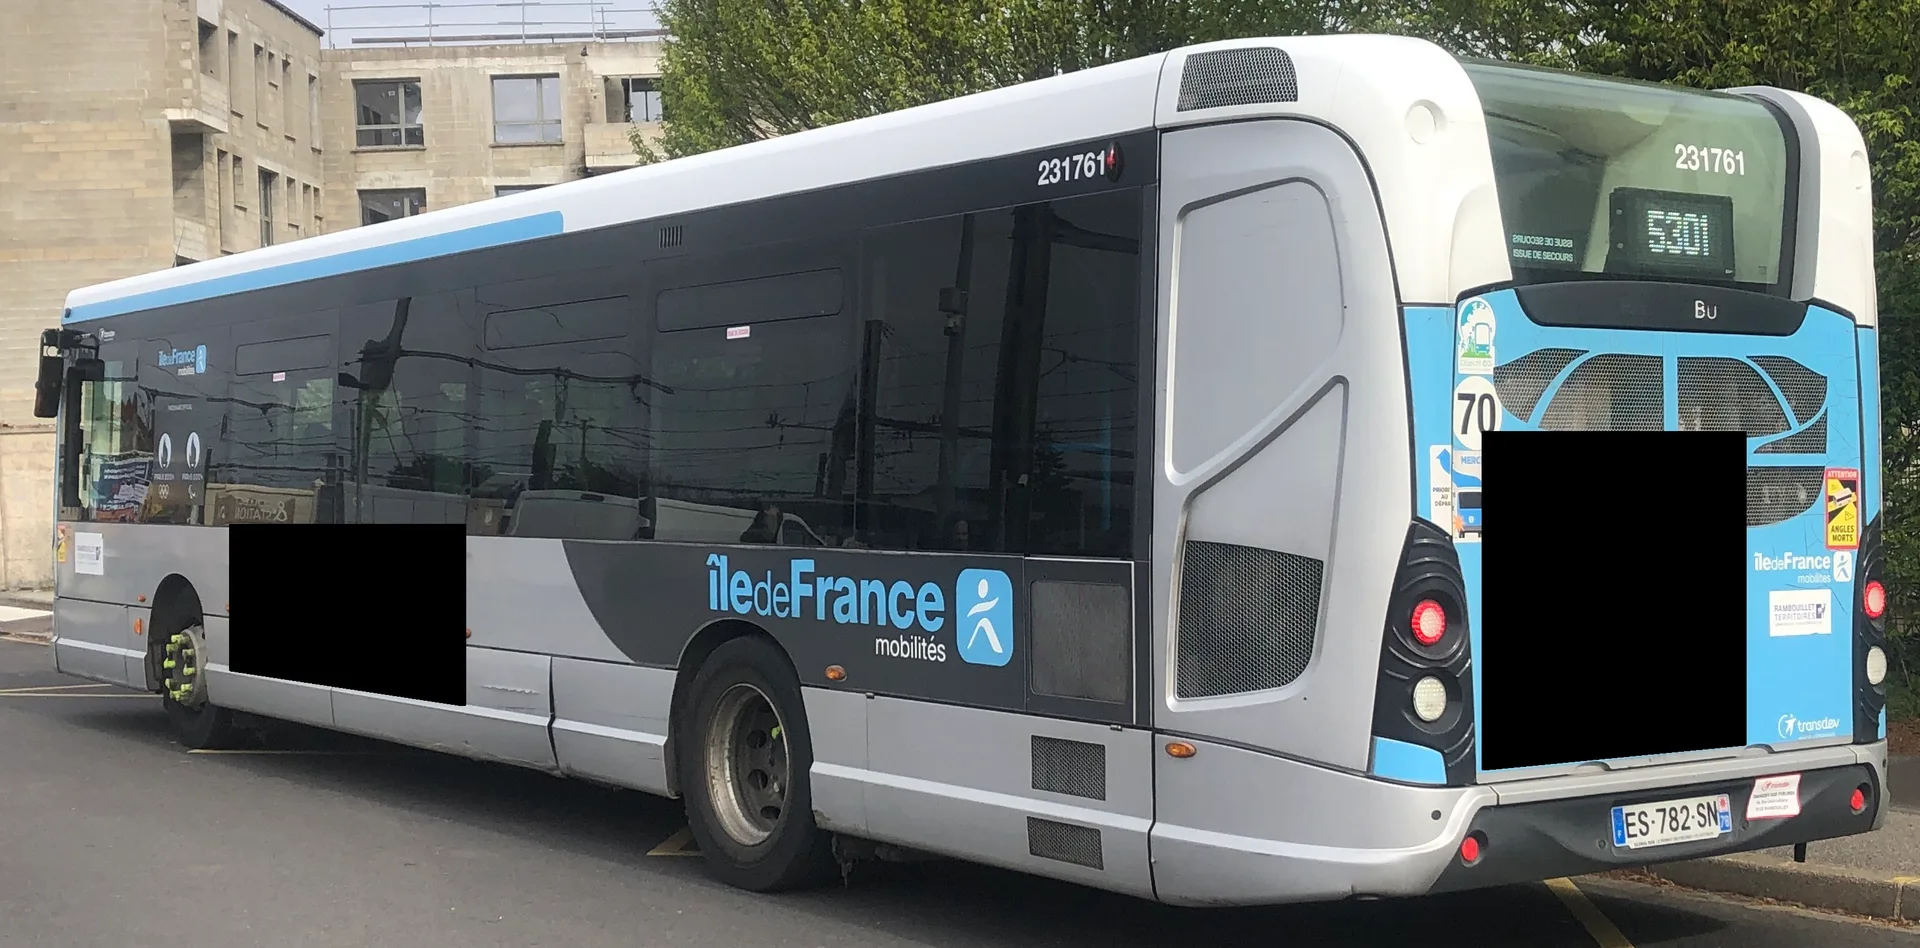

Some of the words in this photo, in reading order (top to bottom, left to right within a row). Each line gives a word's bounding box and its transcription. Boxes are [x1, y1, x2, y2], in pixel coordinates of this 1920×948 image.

[1675, 144, 1744, 175] 231761
[1038, 150, 1105, 185] 231761
[1648, 210, 1709, 255] 5301
[1513, 248, 1532, 258] ISSUE
[1533, 250, 1542, 259] DE
[1543, 250, 1573, 262] SECOURS
[1457, 393, 1496, 434] 70
[1461, 456, 1482, 464] MERC
[1831, 525, 1854, 533] ANGLES
[1832, 534, 1853, 542] MORTS
[706, 553, 945, 632] îledeFrance
[1774, 603, 1815, 612] RAMBOUILLET
[1774, 612, 1816, 621] TERRITOIRES
[875, 635, 946, 663] mobilités
[1798, 717, 1840, 732] transdev
